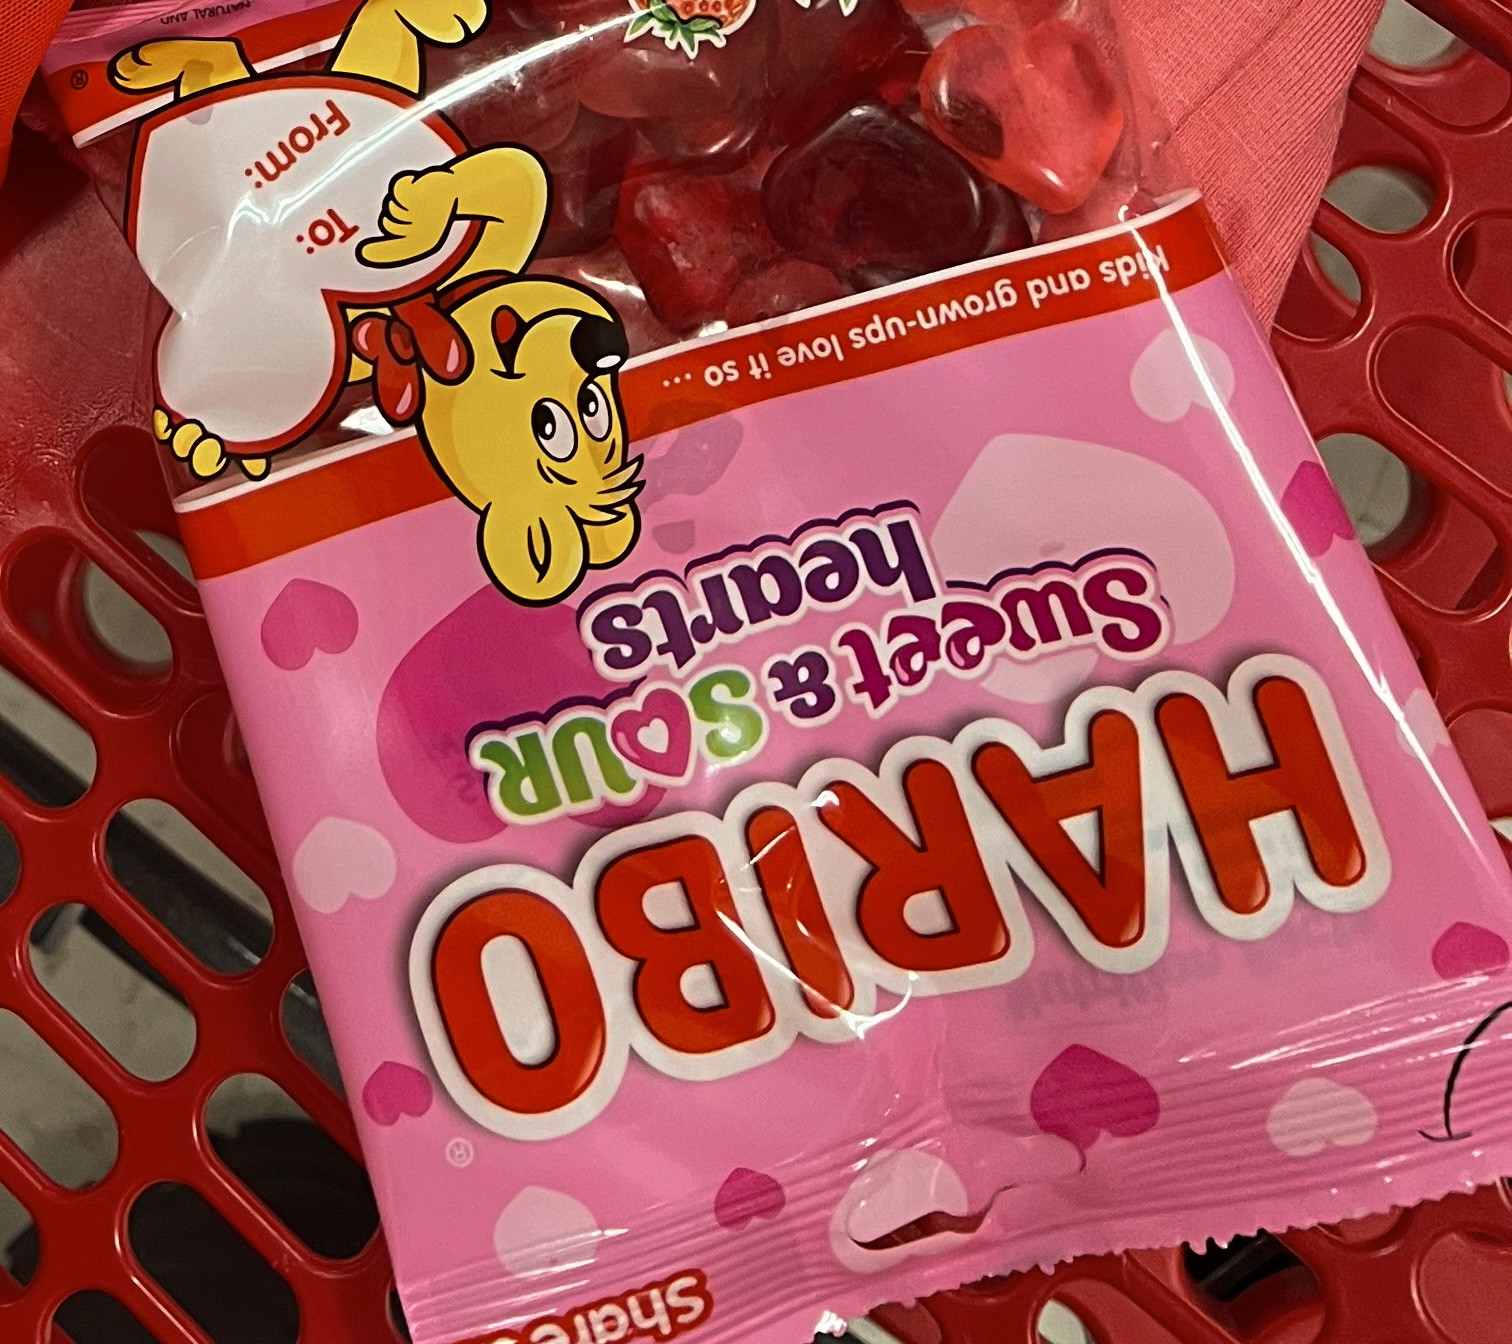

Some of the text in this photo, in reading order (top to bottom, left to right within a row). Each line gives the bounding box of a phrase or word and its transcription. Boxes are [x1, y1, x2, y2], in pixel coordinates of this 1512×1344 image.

[193, 0, 251, 20] NATURAL
[244, 99, 351, 189] From:
[296, 208, 360, 255] To:
[1025, 267, 1091, 308] and
[1098, 245, 1170, 284] Kids
[848, 278, 1018, 351] grown-ups
[703, 359, 738, 387] so
[747, 354, 772, 381] it
[776, 332, 843, 367] love
[589, 518, 937, 672] hearts
[837, 566, 1164, 712] Sweet
[767, 651, 836, 720] &
[429, 673, 1369, 1116] HARIBO
